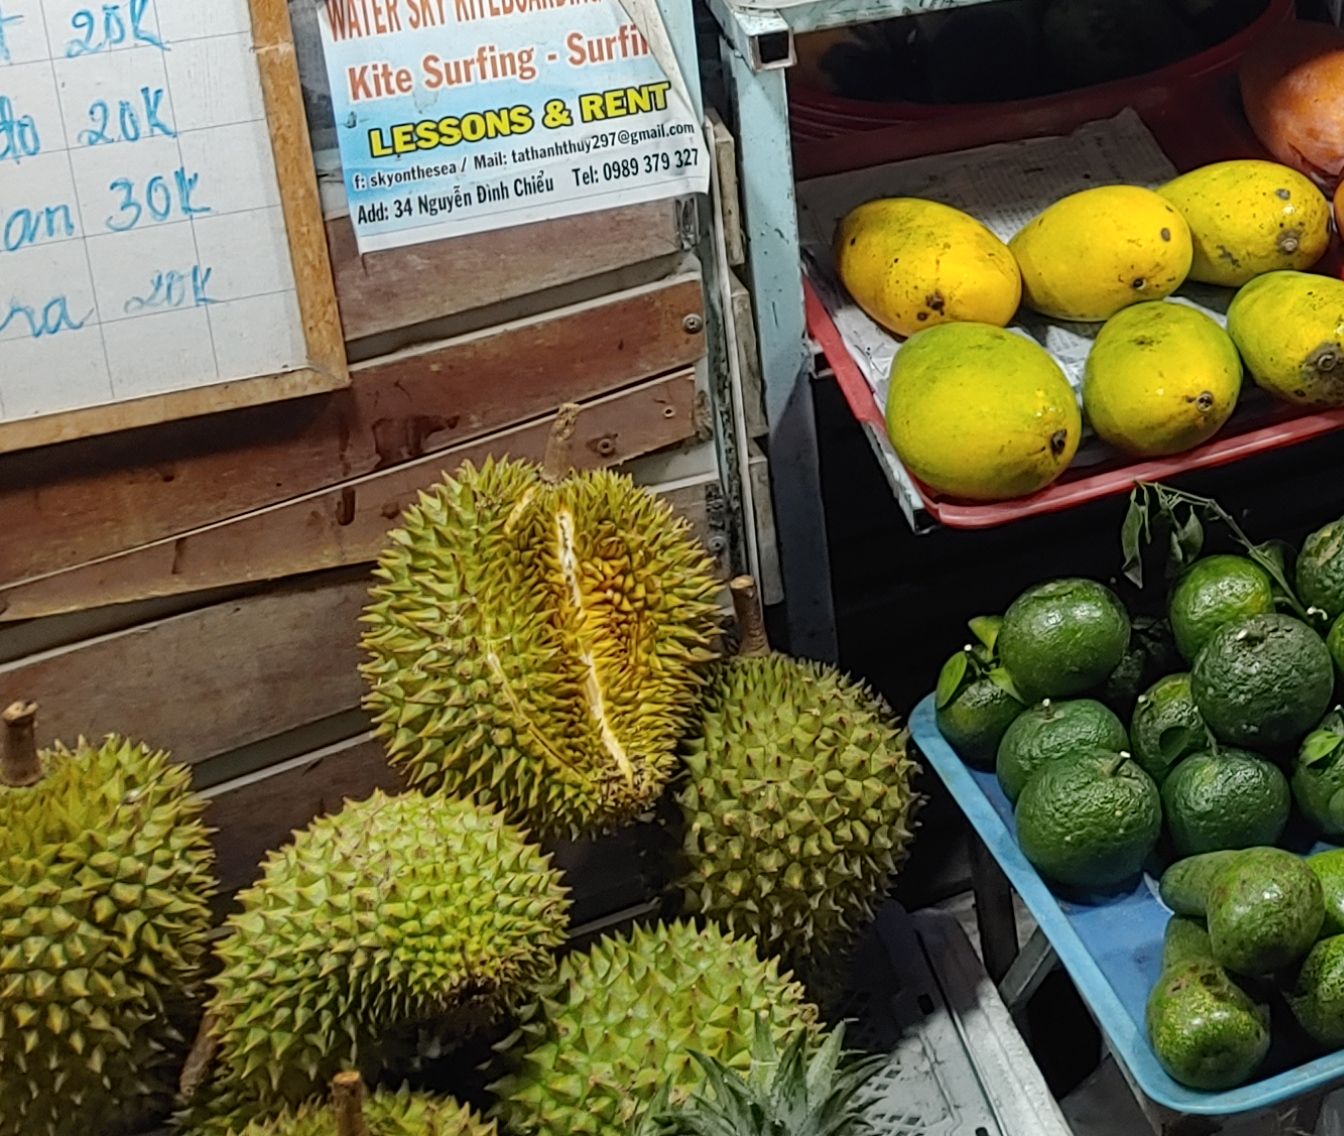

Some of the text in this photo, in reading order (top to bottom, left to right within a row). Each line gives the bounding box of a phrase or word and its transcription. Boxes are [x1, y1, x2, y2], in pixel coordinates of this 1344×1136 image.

[348, 63, 413, 102] Kite
[423, 44, 537, 87] Surfing
[353, 175, 367, 191] f:
[369, 162, 458, 189] skyonthesea
[473, 153, 509, 172] Mail:
[511, 121, 696, 167] tathanhthuy297@gmail.com
[367, 81, 671, 159] LESSONS & RENT
[357, 148, 701, 226] Add: 34 Nguyễn Đình Chiểu Tel: 0989 379 327
